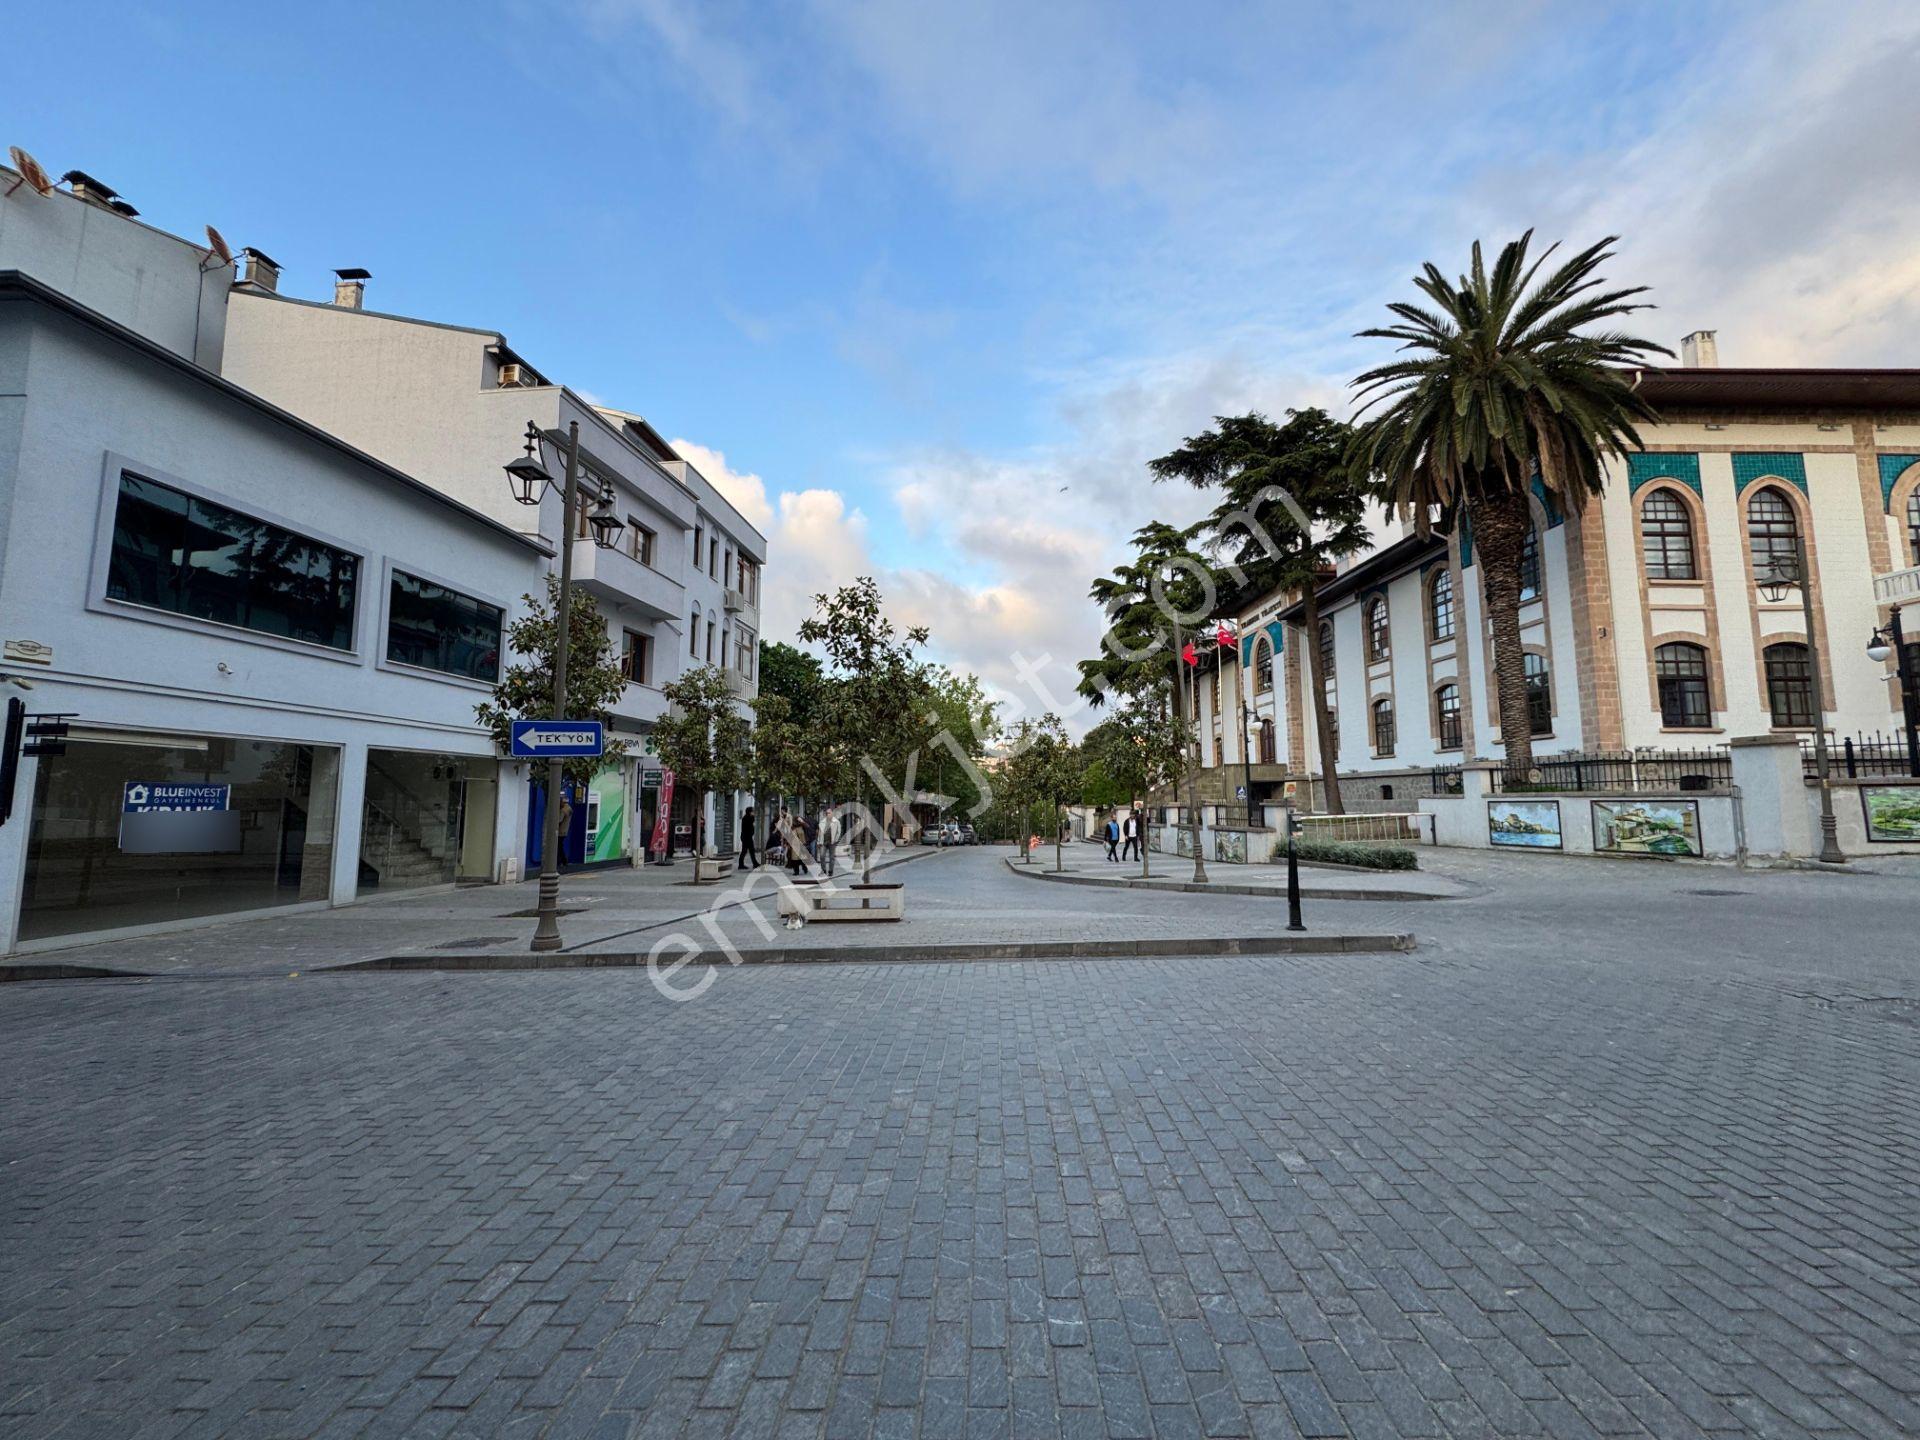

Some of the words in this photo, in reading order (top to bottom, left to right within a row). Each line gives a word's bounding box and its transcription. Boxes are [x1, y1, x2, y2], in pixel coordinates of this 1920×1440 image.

[537, 734, 561, 743] TEK
[568, 733, 593, 743] YÖN
[154, 787, 222, 797] BLUEINVEST
